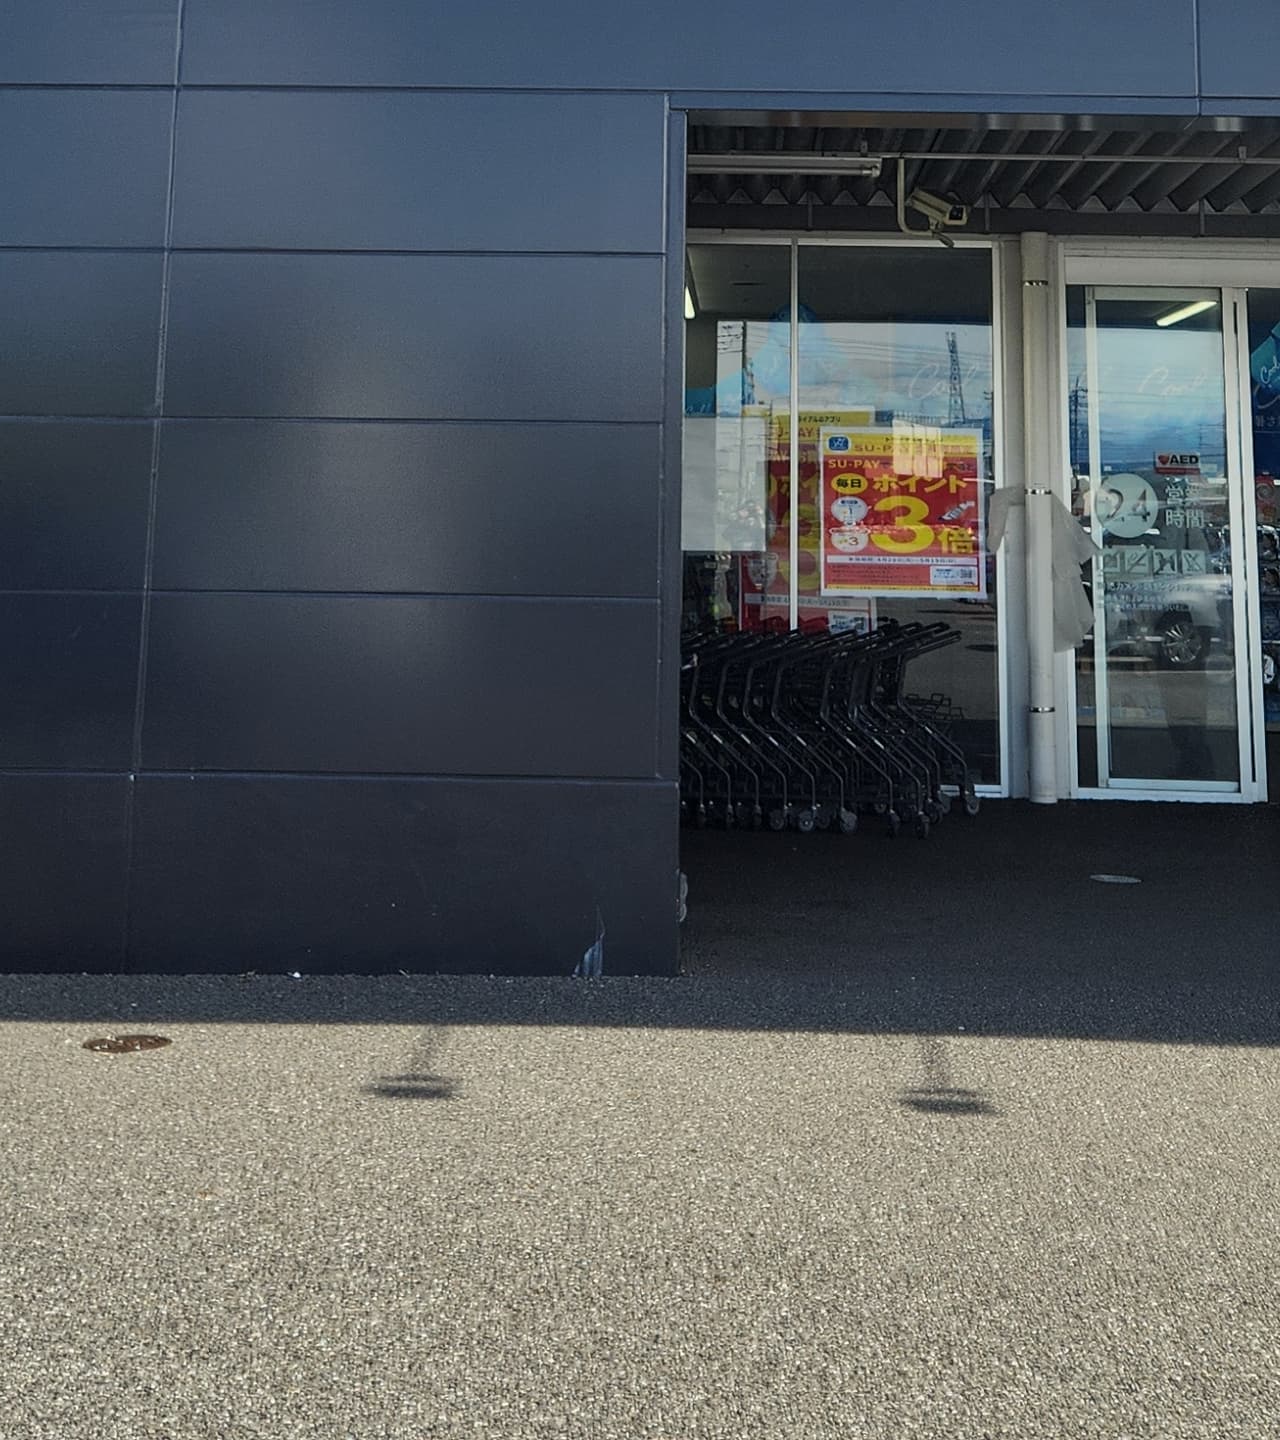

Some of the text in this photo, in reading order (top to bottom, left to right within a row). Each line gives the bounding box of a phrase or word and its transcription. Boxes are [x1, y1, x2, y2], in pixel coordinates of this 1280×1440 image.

[1170, 454, 1199, 465] AED
[836, 474, 968, 494] 毎日 ポイント
[1102, 488, 1151, 523] 24
[1165, 509, 1206, 529] 時間
